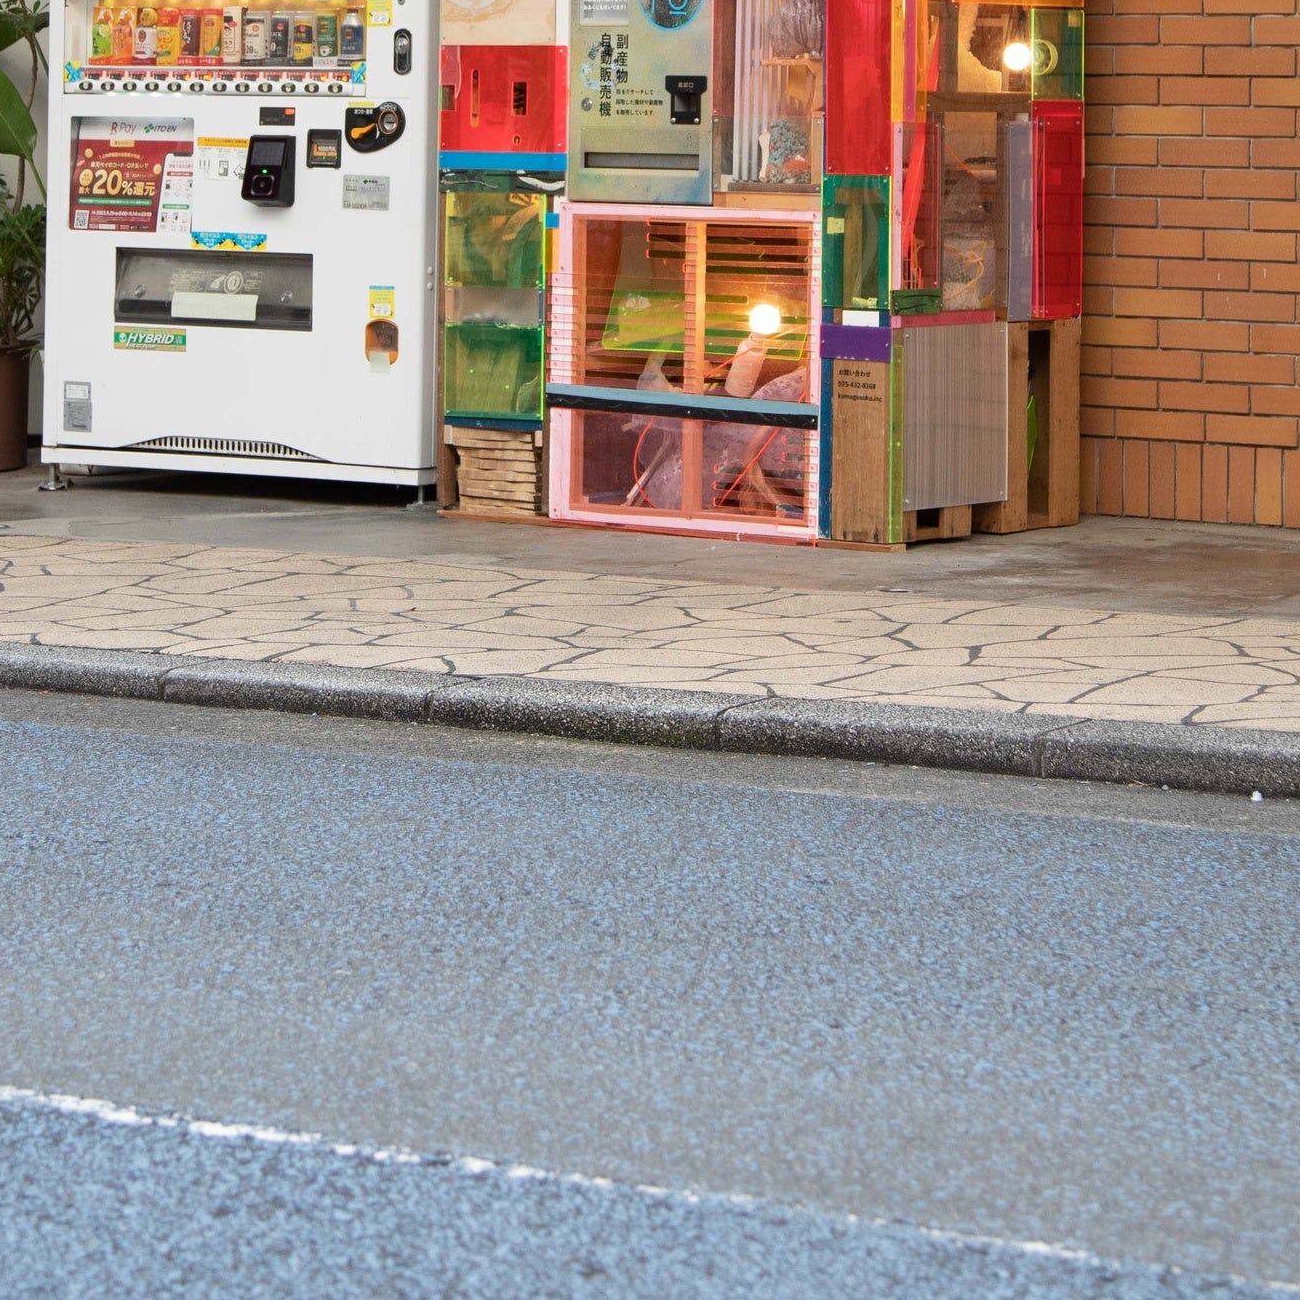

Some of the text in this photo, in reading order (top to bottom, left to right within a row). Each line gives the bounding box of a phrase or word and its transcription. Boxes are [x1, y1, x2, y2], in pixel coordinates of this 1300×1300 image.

[616, 33, 629, 84] 副産物
[599, 32, 612, 117] 自動販売機
[119, 122, 137, 135] Pay
[153, 125, 177, 133] ITO EN
[127, 332, 174, 346] HYBRID
